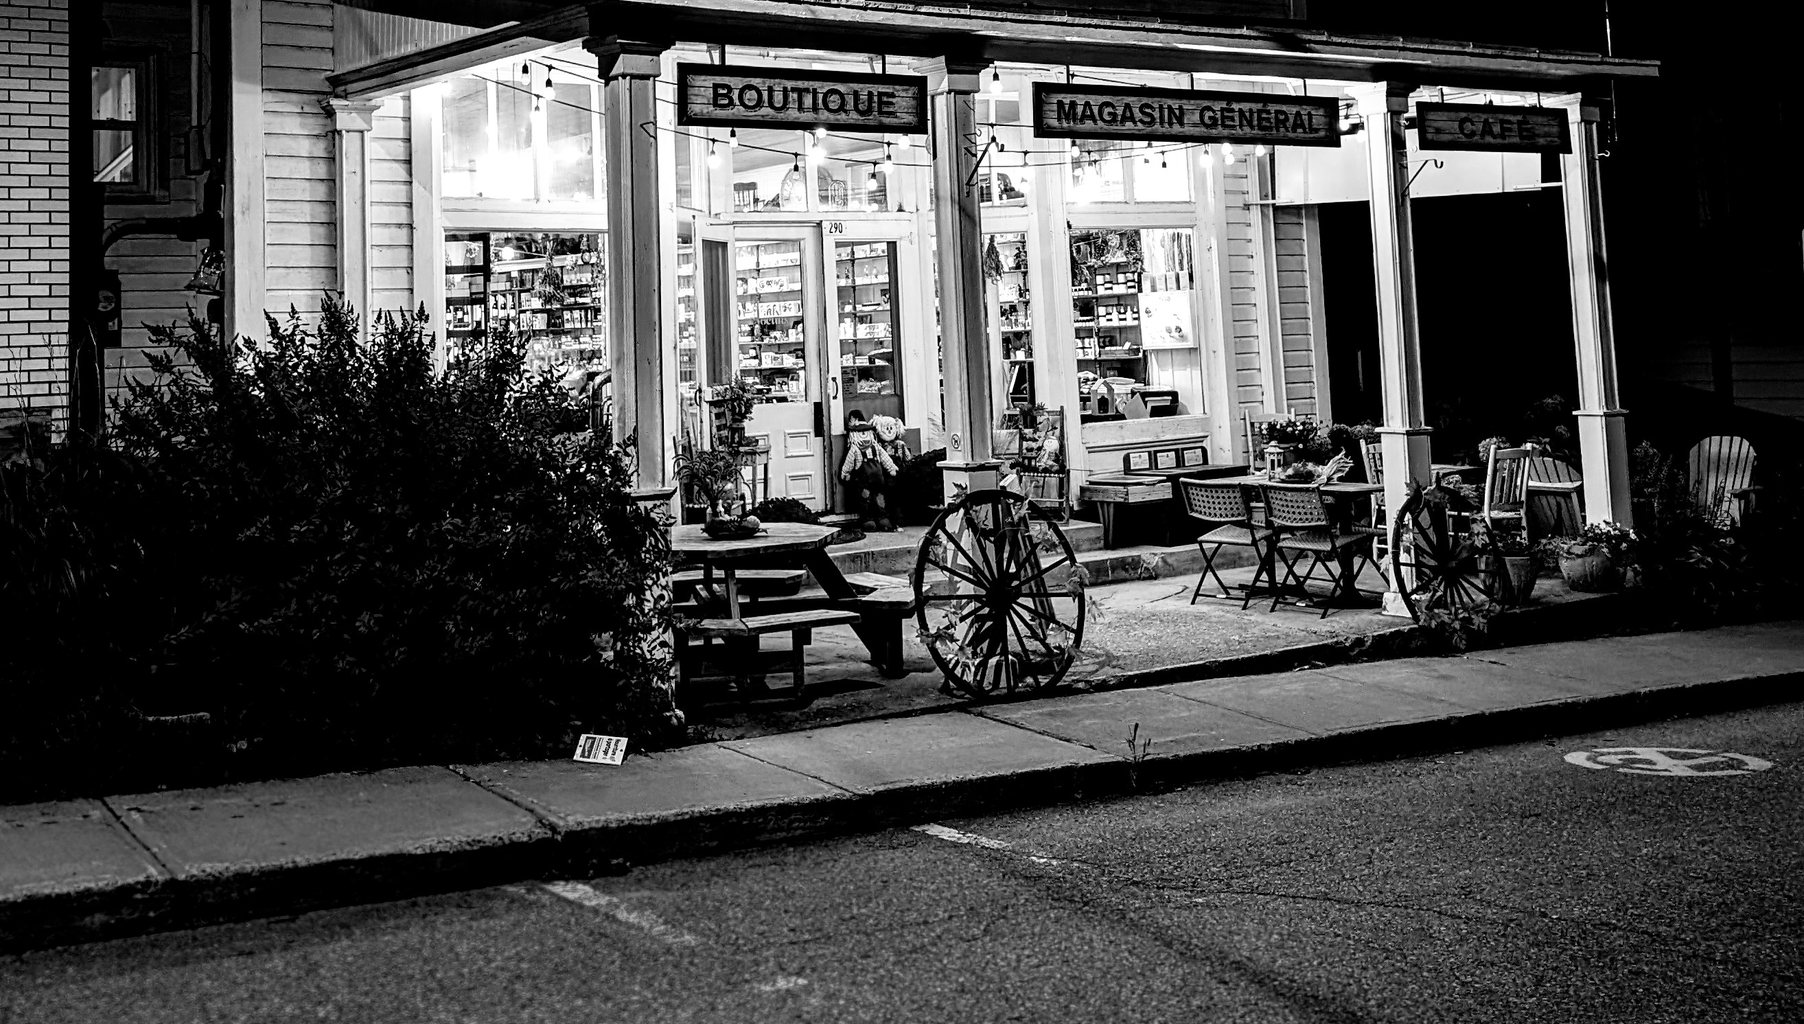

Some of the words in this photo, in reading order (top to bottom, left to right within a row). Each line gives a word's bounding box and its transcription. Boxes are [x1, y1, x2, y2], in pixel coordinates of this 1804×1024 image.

[711, 82, 898, 117] BOUTIQUE
[1056, 98, 1186, 129] MAGASIN
[1199, 102, 1320, 135] GÉNÉRAL
[1458, 114, 1537, 142] CAFÉ
[829, 222, 843, 234] 290
